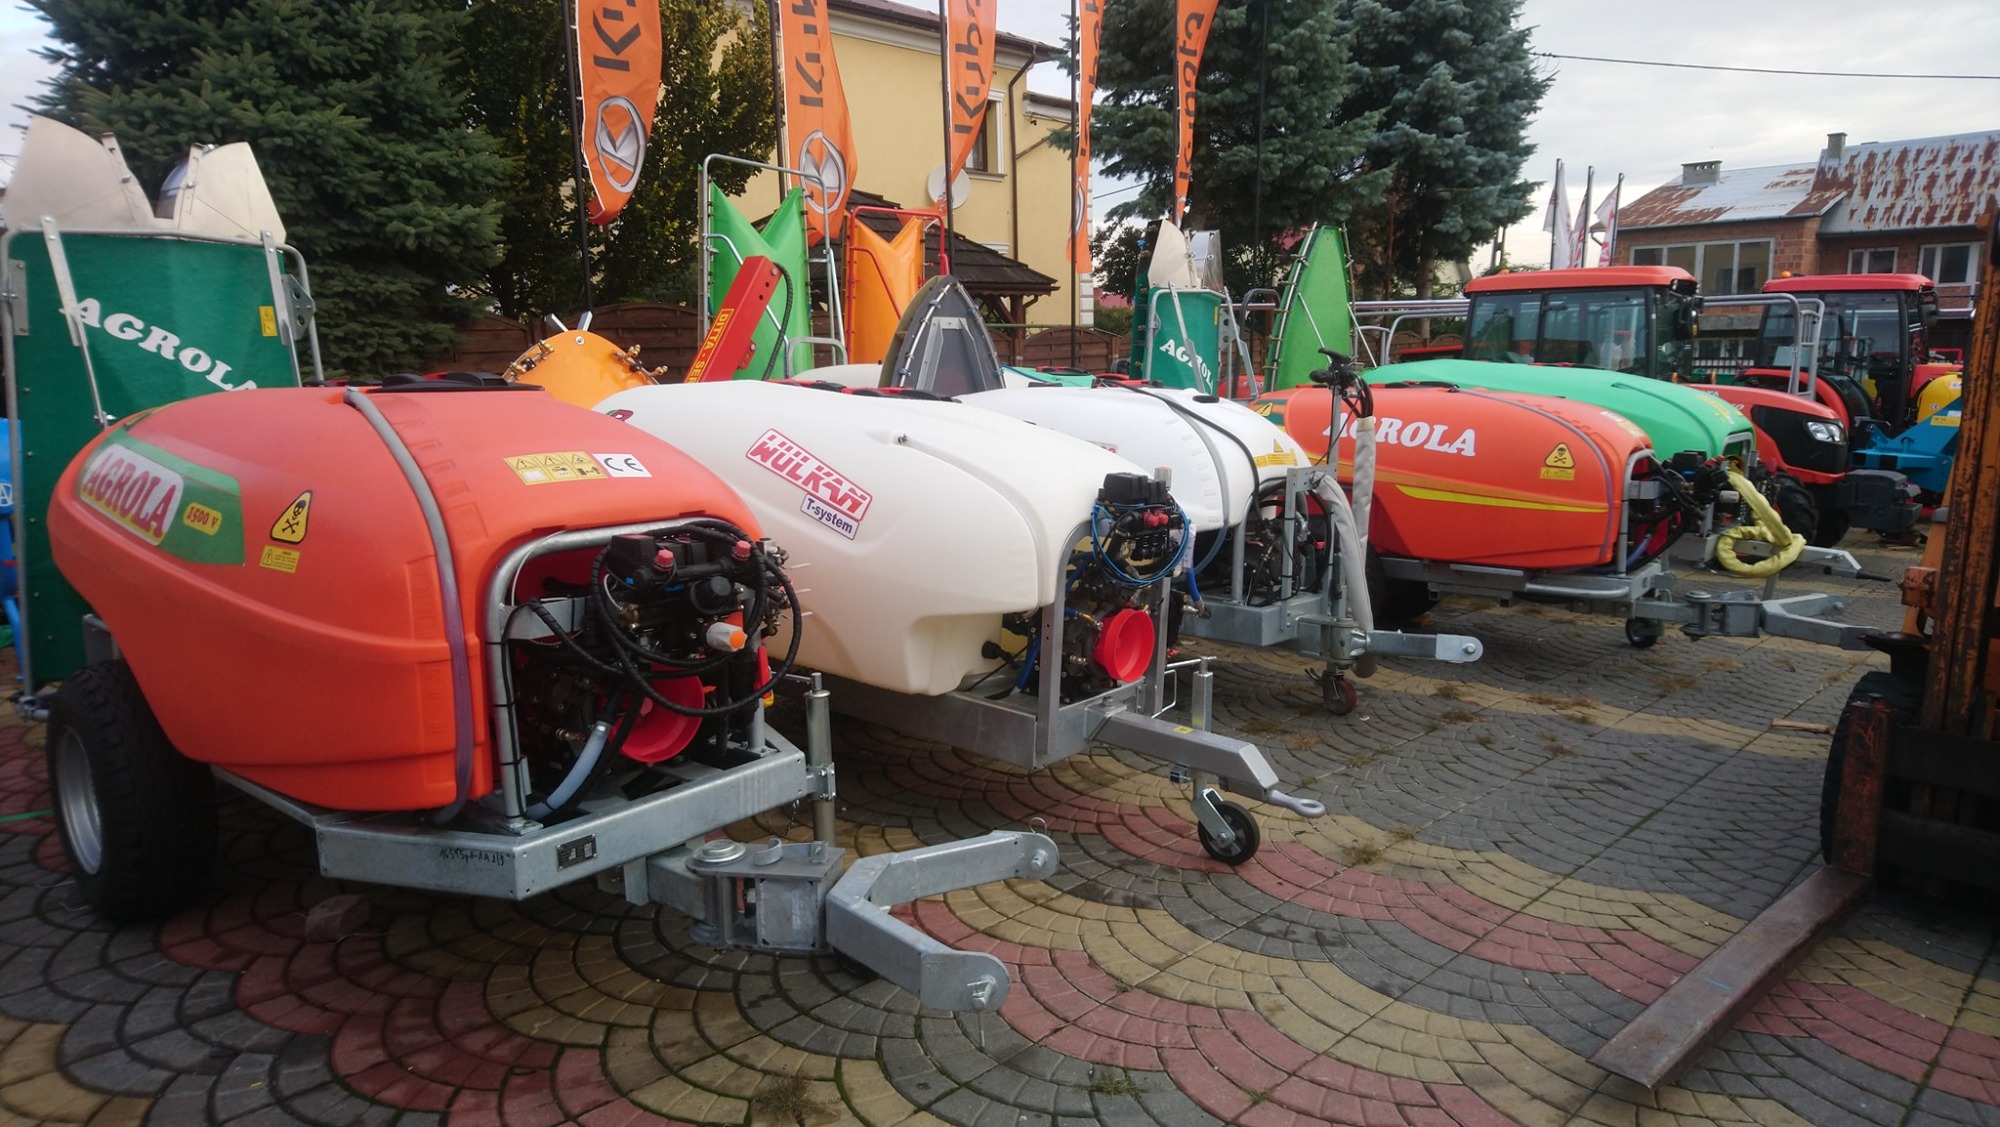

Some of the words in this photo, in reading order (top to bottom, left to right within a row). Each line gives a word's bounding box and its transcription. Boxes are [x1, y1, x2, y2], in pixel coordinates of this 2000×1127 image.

[703, 313, 729, 350] DITTA
[83, 452, 177, 540] AGROLA
[187, 506, 209, 526] 1500
[806, 497, 854, 534] T-system
